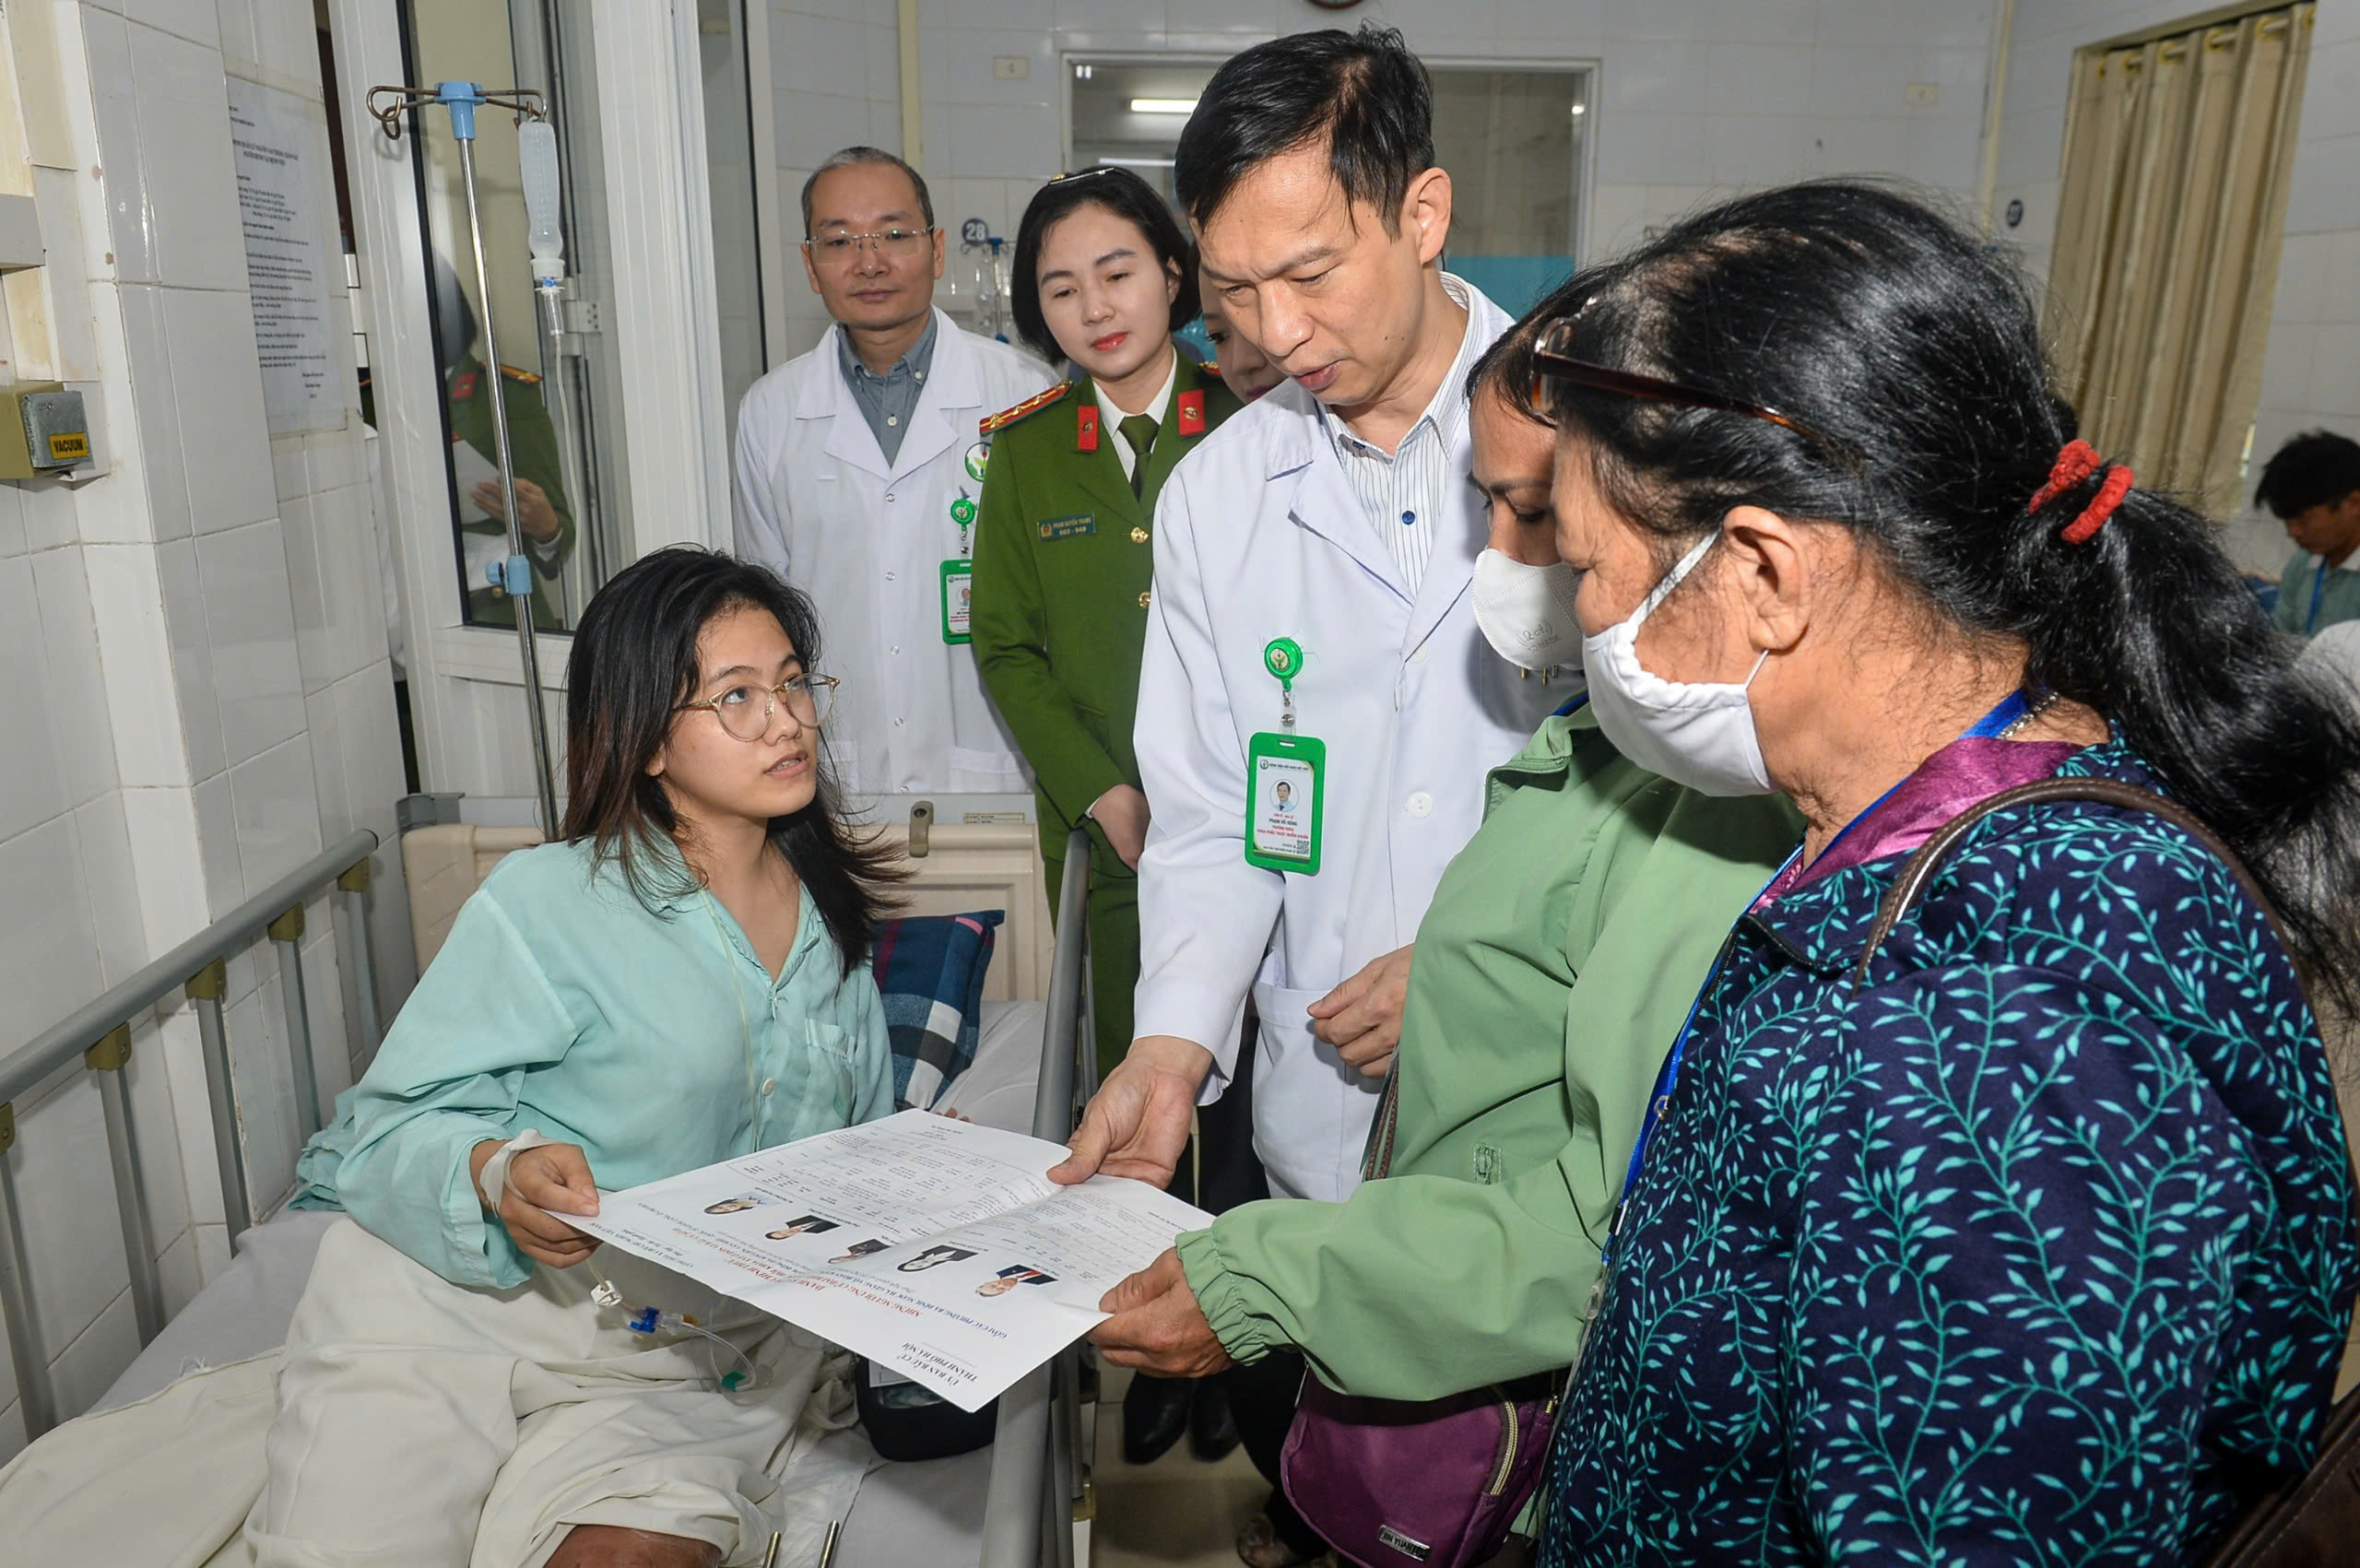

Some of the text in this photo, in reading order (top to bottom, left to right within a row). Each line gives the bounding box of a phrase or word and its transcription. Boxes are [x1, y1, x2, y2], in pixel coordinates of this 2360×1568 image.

[966, 222, 985, 241] 28
[53, 438, 83, 453] VACUUM
[796, 1279, 826, 1291] DANH
[865, 1293, 891, 1307] NGƯỜI
[892, 1303, 922, 1317] NHỮNG
[972, 1322, 989, 1331] CÁC
[988, 1327, 1008, 1338] GỒM
[902, 1342, 977, 1382] THÀNH PHỐ HÀ NỘI
[912, 1359, 929, 1370] BẦU
[927, 1367, 947, 1377] BAN
